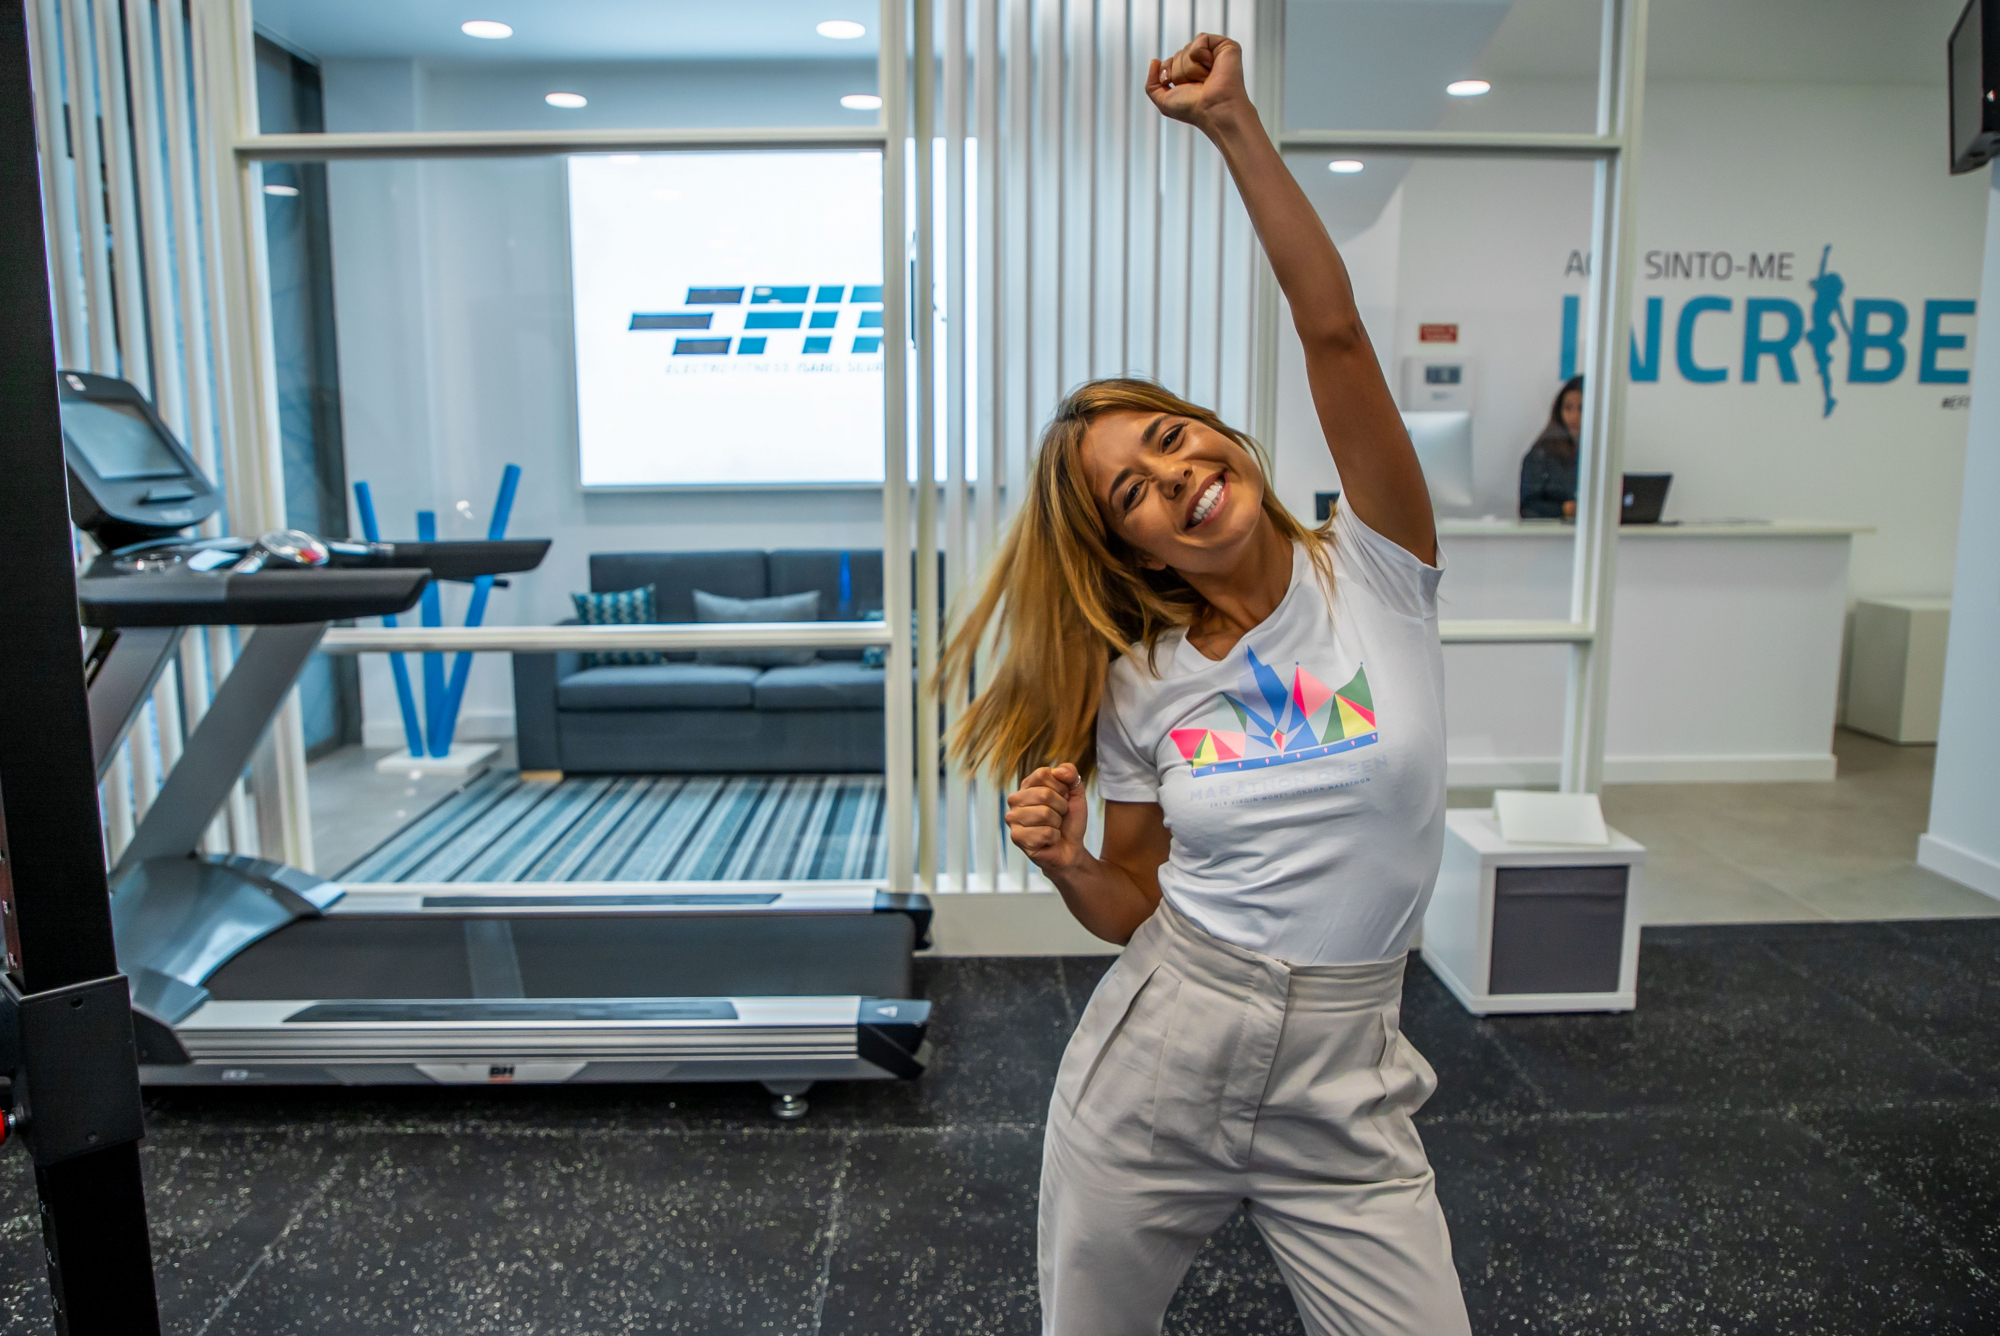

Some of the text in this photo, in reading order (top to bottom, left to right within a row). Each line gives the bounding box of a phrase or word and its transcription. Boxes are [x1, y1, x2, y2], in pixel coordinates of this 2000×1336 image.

[1645, 250, 1795, 281] SINTO-ME
[1190, 754, 1388, 801] MARATHON QUEEN
[1230, 797, 1258, 806] VIRGIN
[1261, 792, 1289, 801] MONEY
[1292, 786, 1325, 796] LONDON
[1328, 777, 1370, 790] MARATHON
